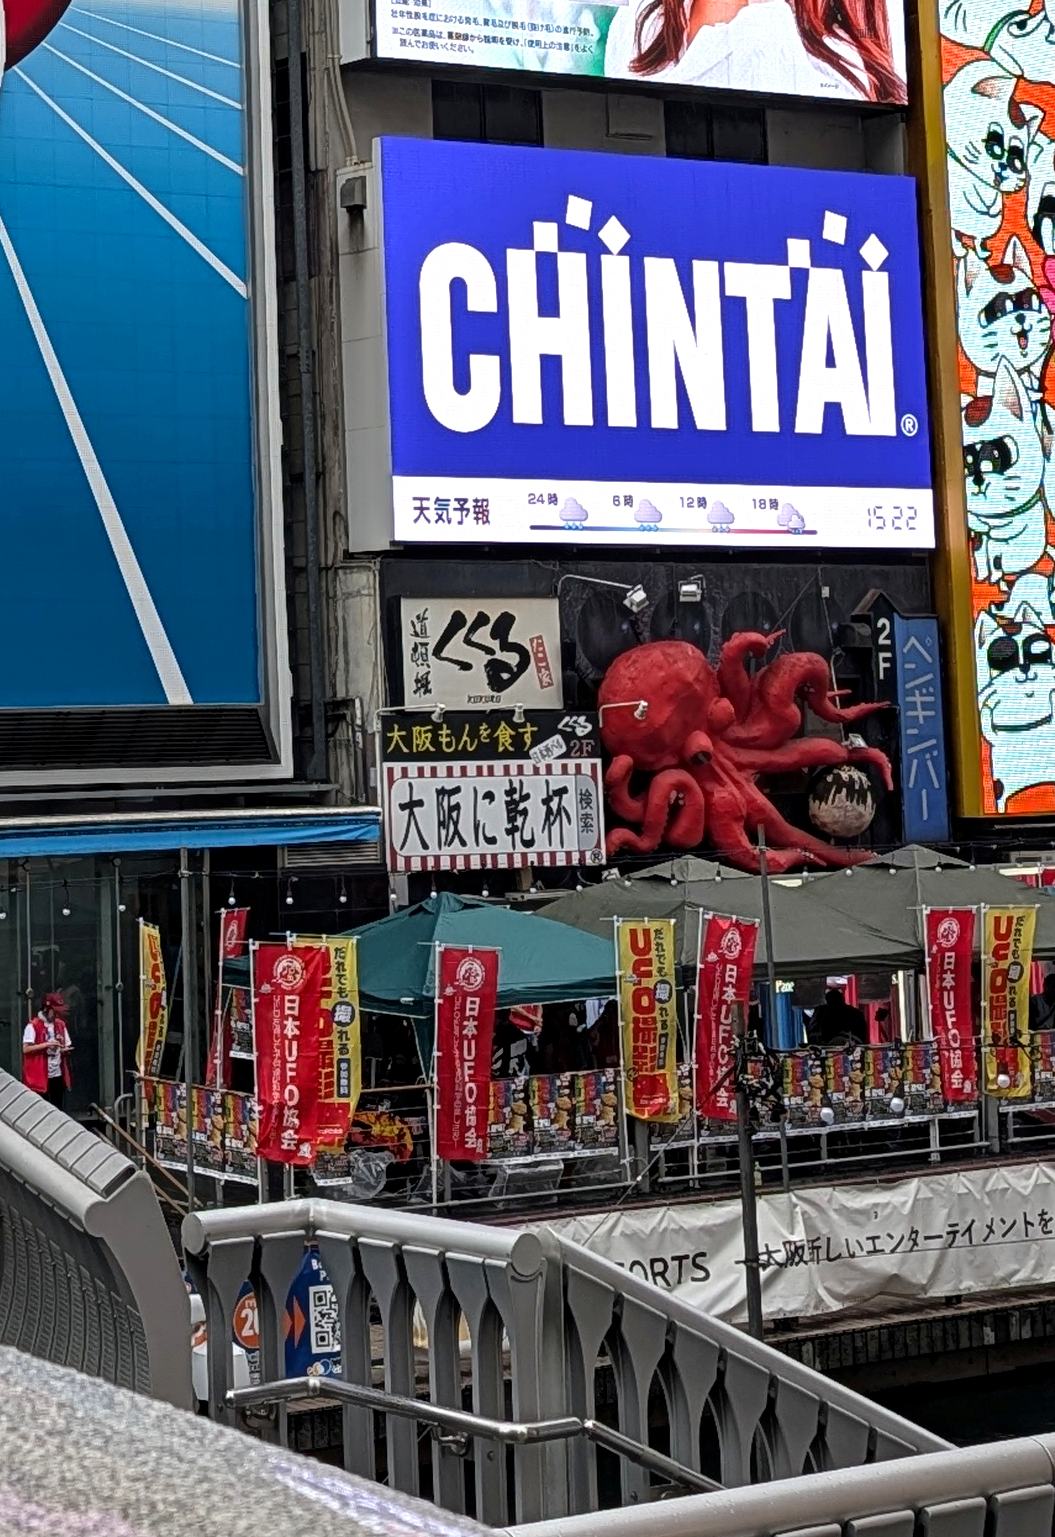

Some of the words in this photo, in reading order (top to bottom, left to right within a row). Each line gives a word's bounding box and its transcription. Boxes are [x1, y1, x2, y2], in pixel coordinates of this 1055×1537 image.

[412, 497, 491, 526] 天気予報
[431, 610, 531, 693] くくる
[876, 616, 892, 680] 2F
[386, 721, 538, 753] 大阪もんを食す
[569, 739, 595, 757] 2F
[902, 634, 940, 821] ペンギンバー
[398, 778, 572, 852] 大阪に乾杯
[579, 788, 594, 834] 検索
[614, 1251, 711, 1287] ORTS
